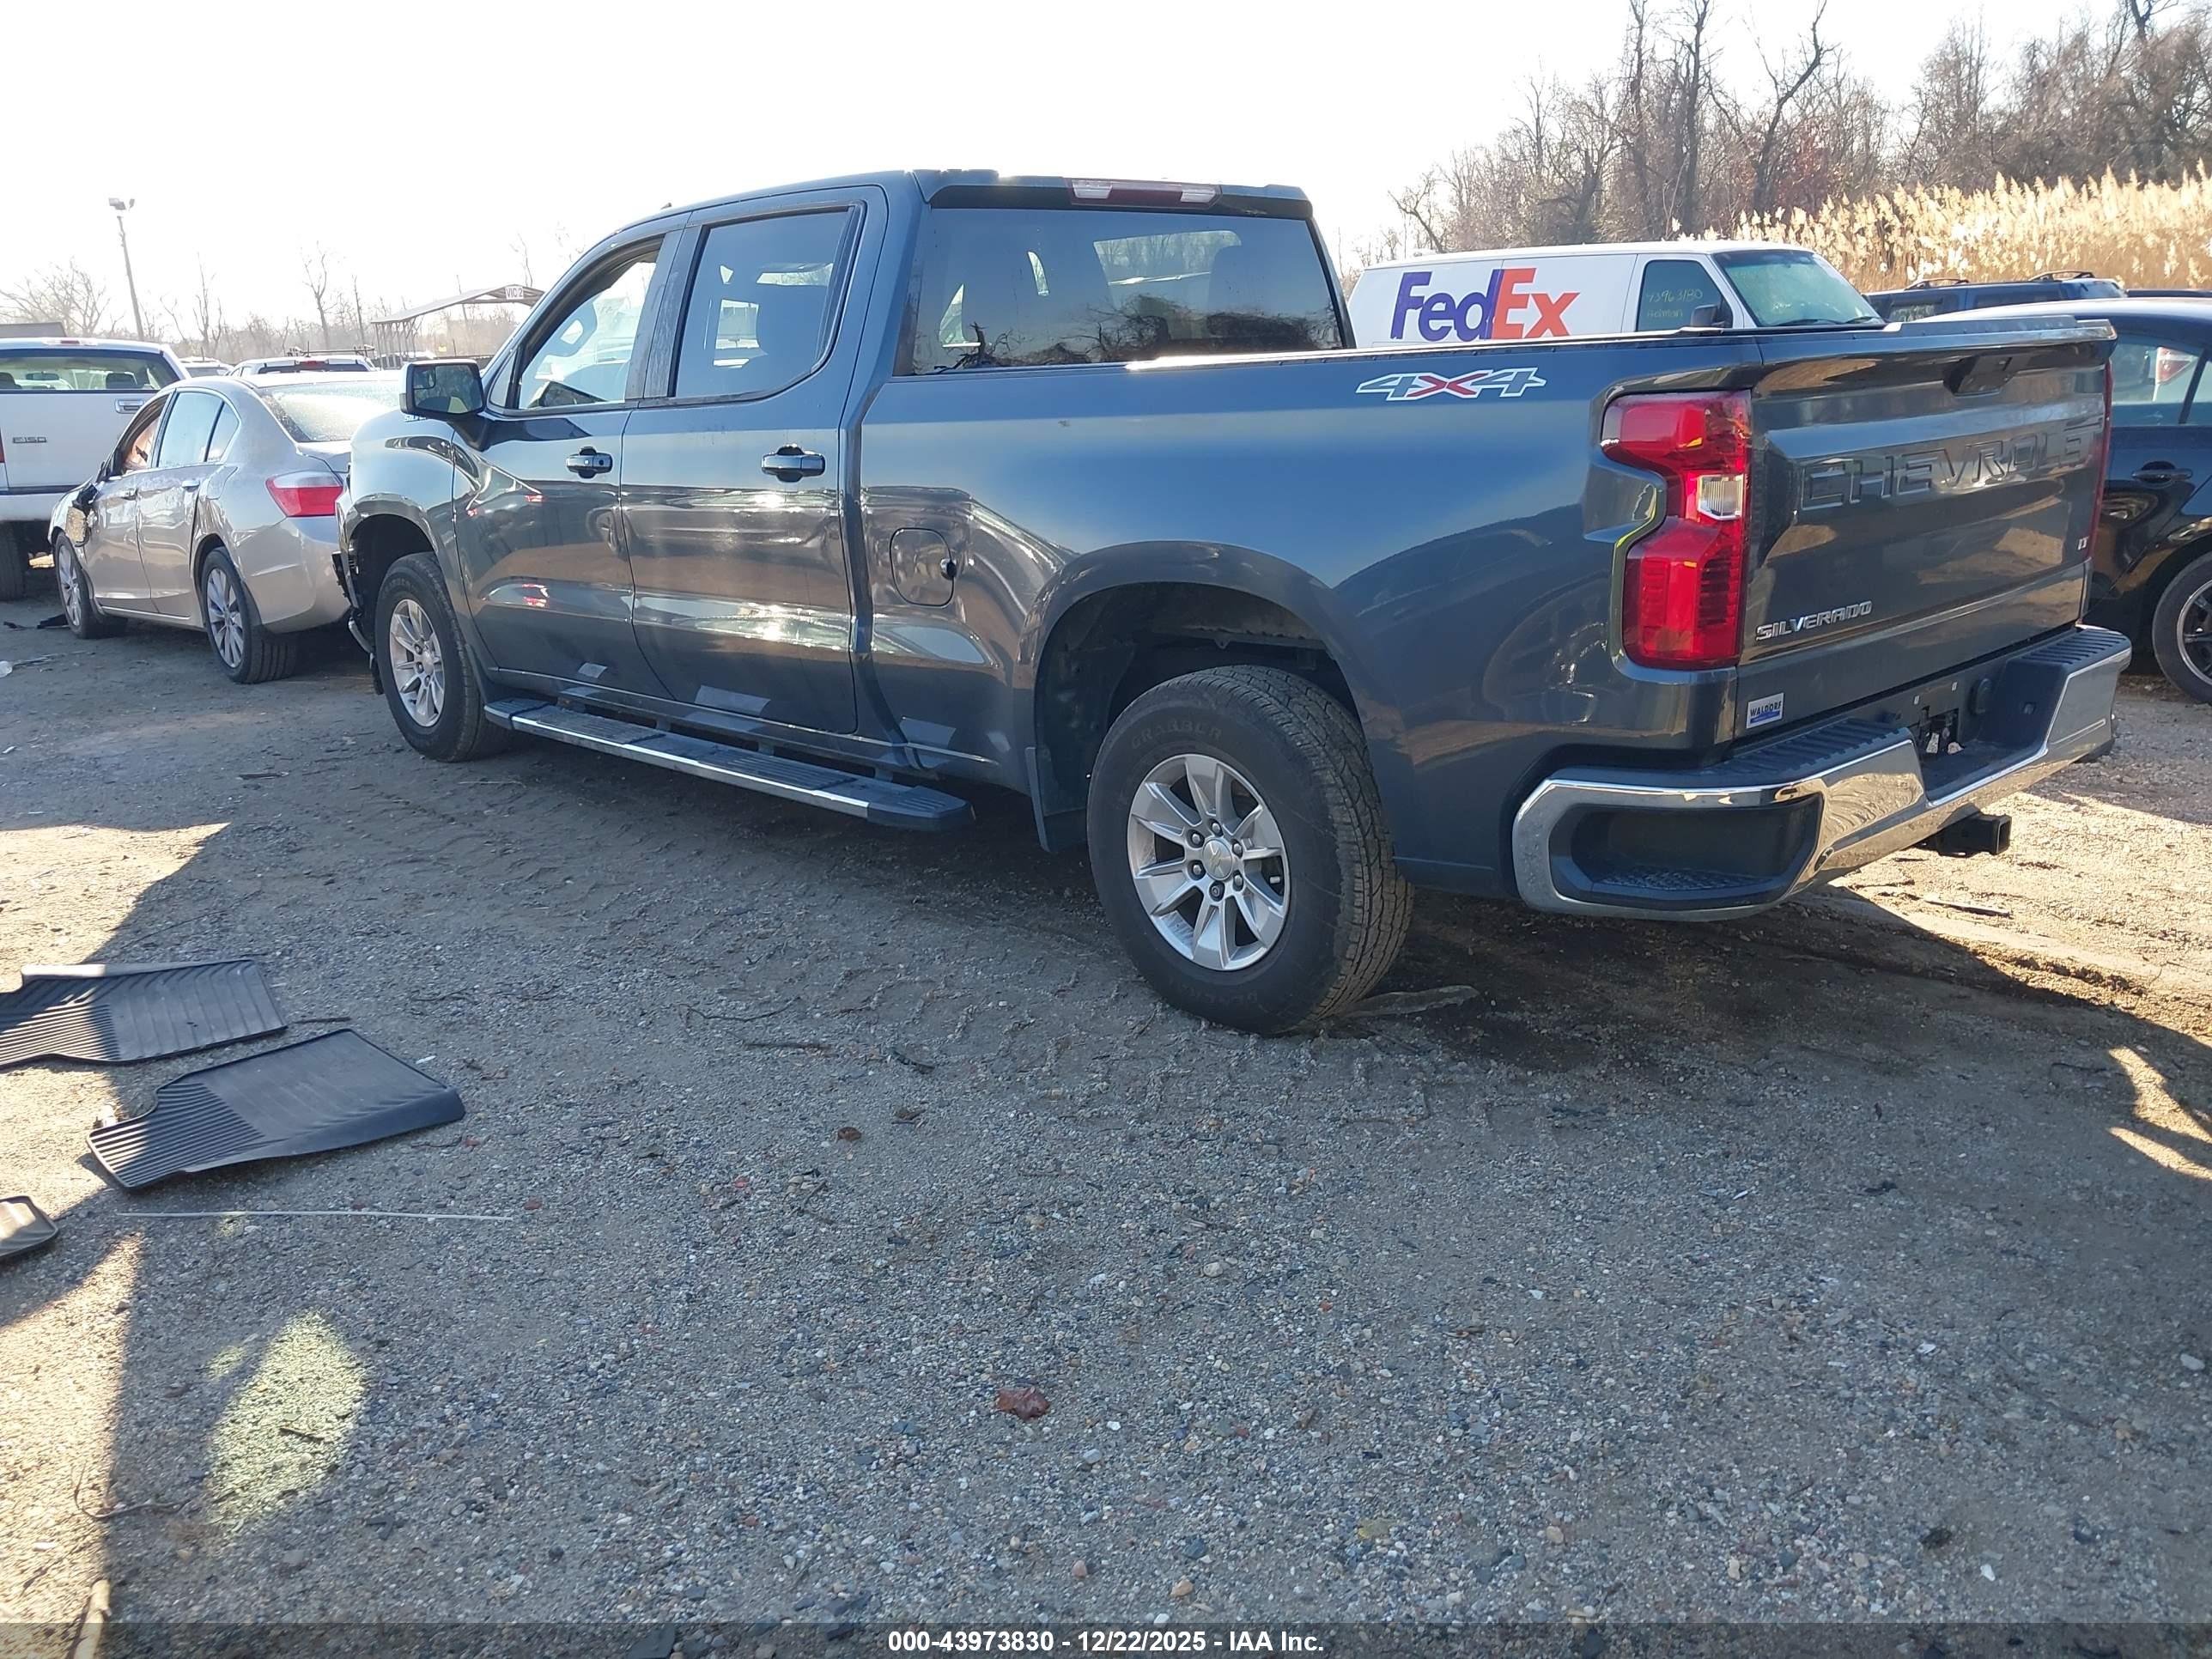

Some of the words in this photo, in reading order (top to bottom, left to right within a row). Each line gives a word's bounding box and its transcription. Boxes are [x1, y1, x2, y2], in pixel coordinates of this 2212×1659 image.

[506, 288, 518, 298] VIC
[518, 288, 523, 298] 2
[1390, 268, 1580, 342] FedEx
[1755, 600, 1872, 641] SILVERADO
[1749, 700, 1782, 717] WALDORF
